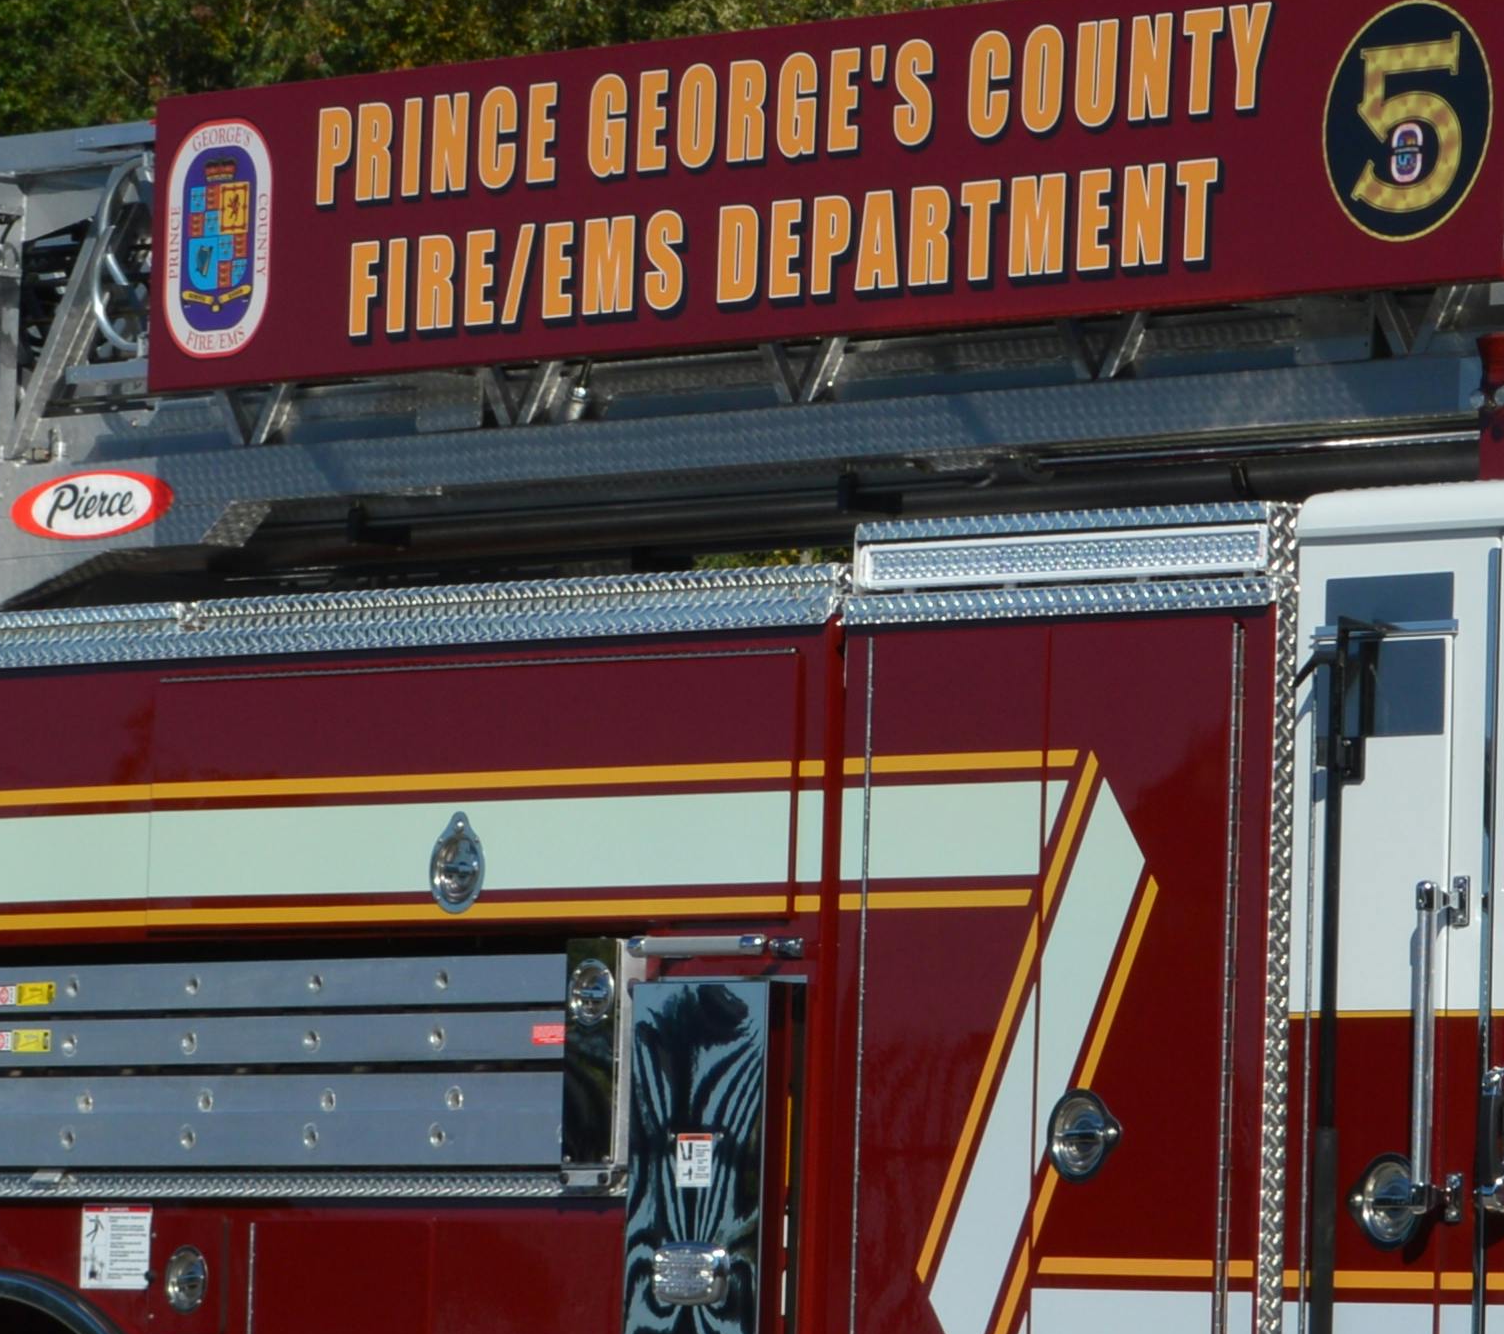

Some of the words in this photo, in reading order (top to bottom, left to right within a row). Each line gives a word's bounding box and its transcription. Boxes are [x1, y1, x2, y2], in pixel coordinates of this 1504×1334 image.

[191, 126, 252, 153] GEORGE'S
[314, 81, 559, 205] PRINCE
[586, 37, 935, 177] GEORGE'S
[967, 0, 1272, 138] COUNTY
[1350, 29, 1463, 213] 5
[168, 205, 182, 280] PRINCE
[256, 191, 269, 277] COUNTY
[347, 208, 685, 336] FIRE/EMS
[715, 158, 1219, 303] DEPARTMENT
[46, 483, 135, 529] Pierce
